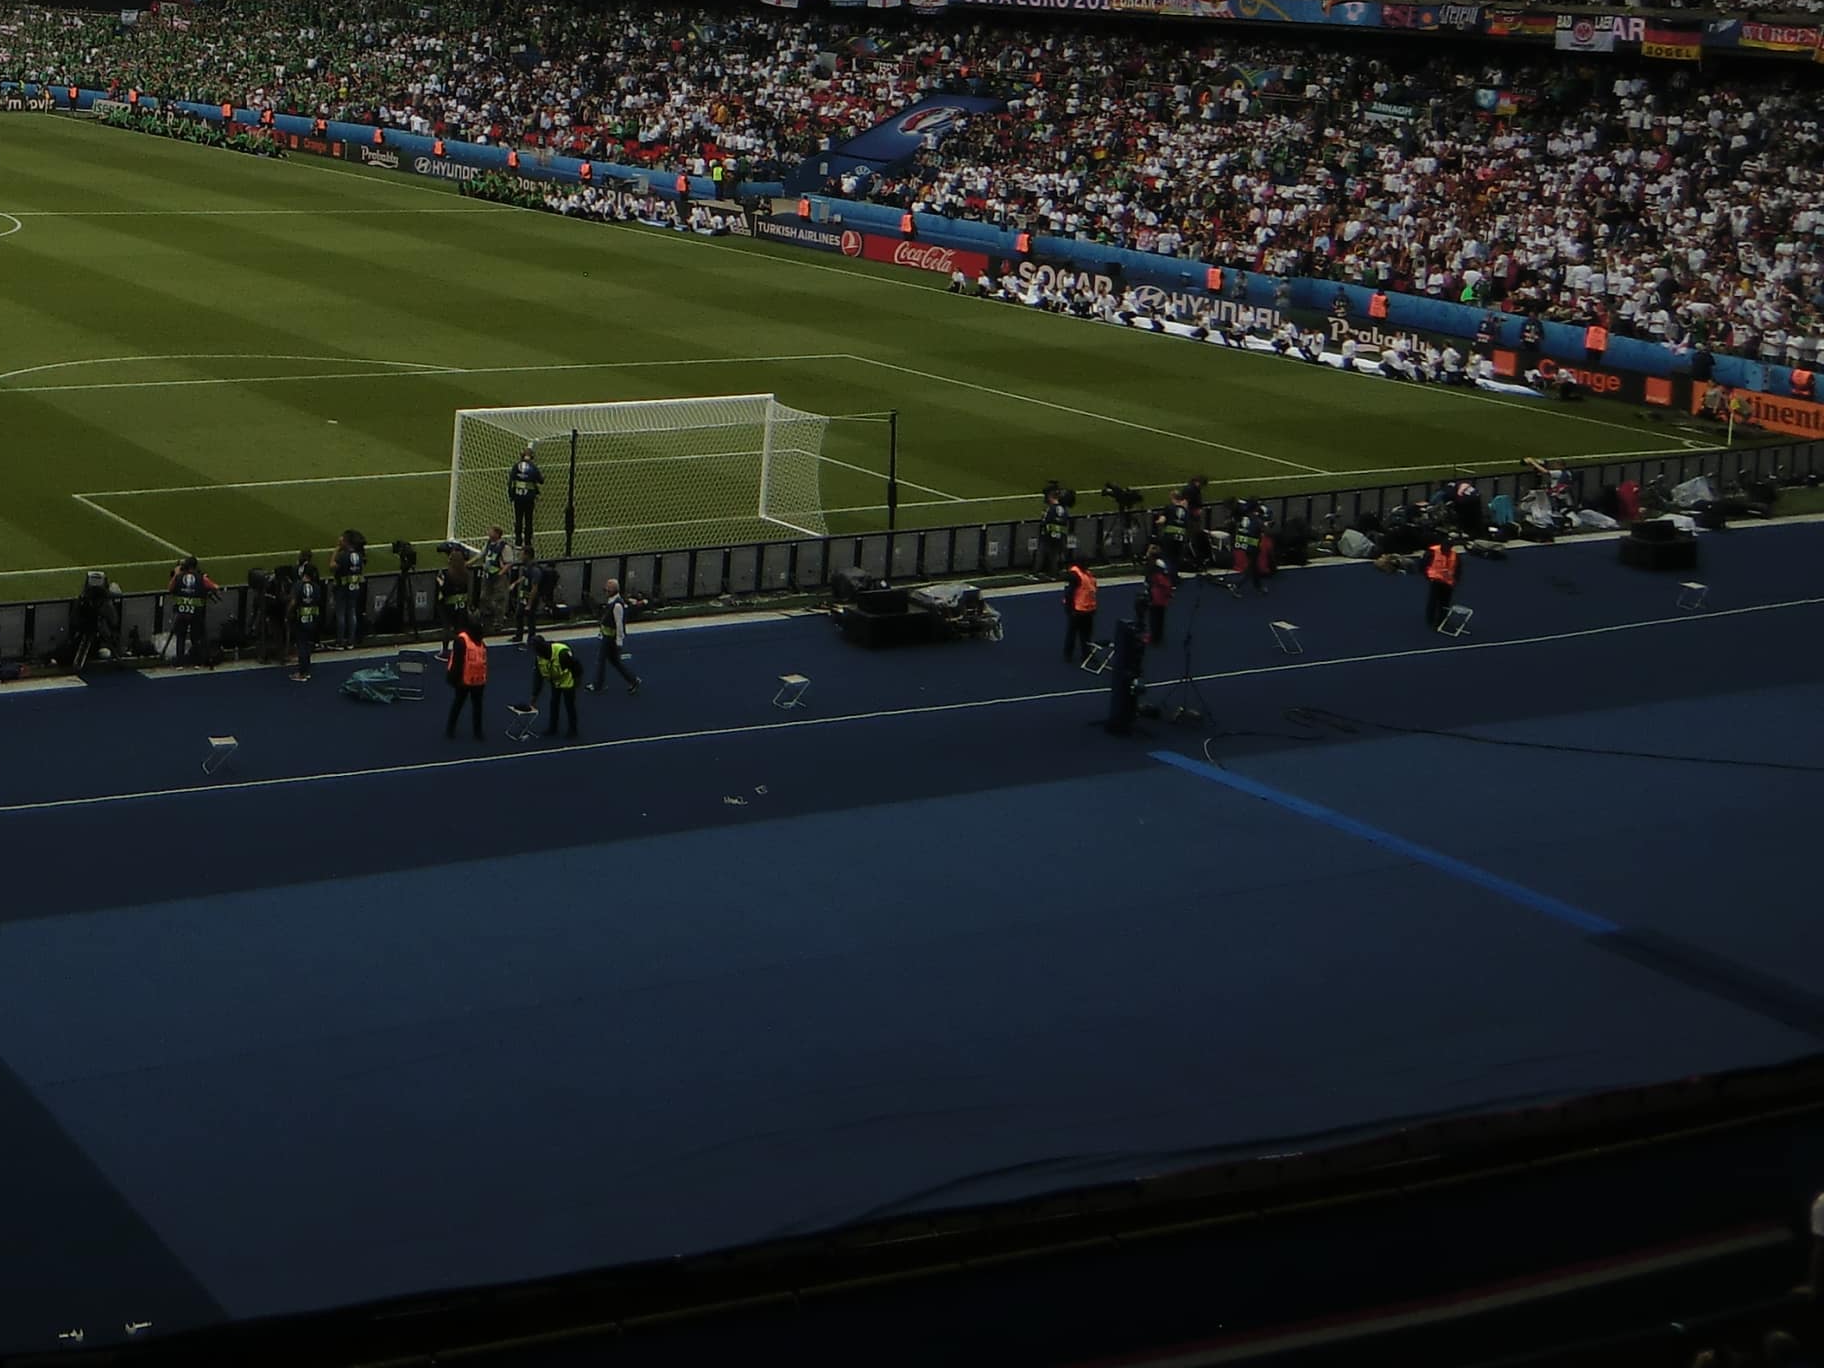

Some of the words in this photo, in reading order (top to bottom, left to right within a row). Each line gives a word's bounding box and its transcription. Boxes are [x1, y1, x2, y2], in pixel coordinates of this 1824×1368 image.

[360, 144, 399, 168] Probably
[757, 220, 797, 239] TURKISH
[797, 229, 841, 246] AIRLINES
